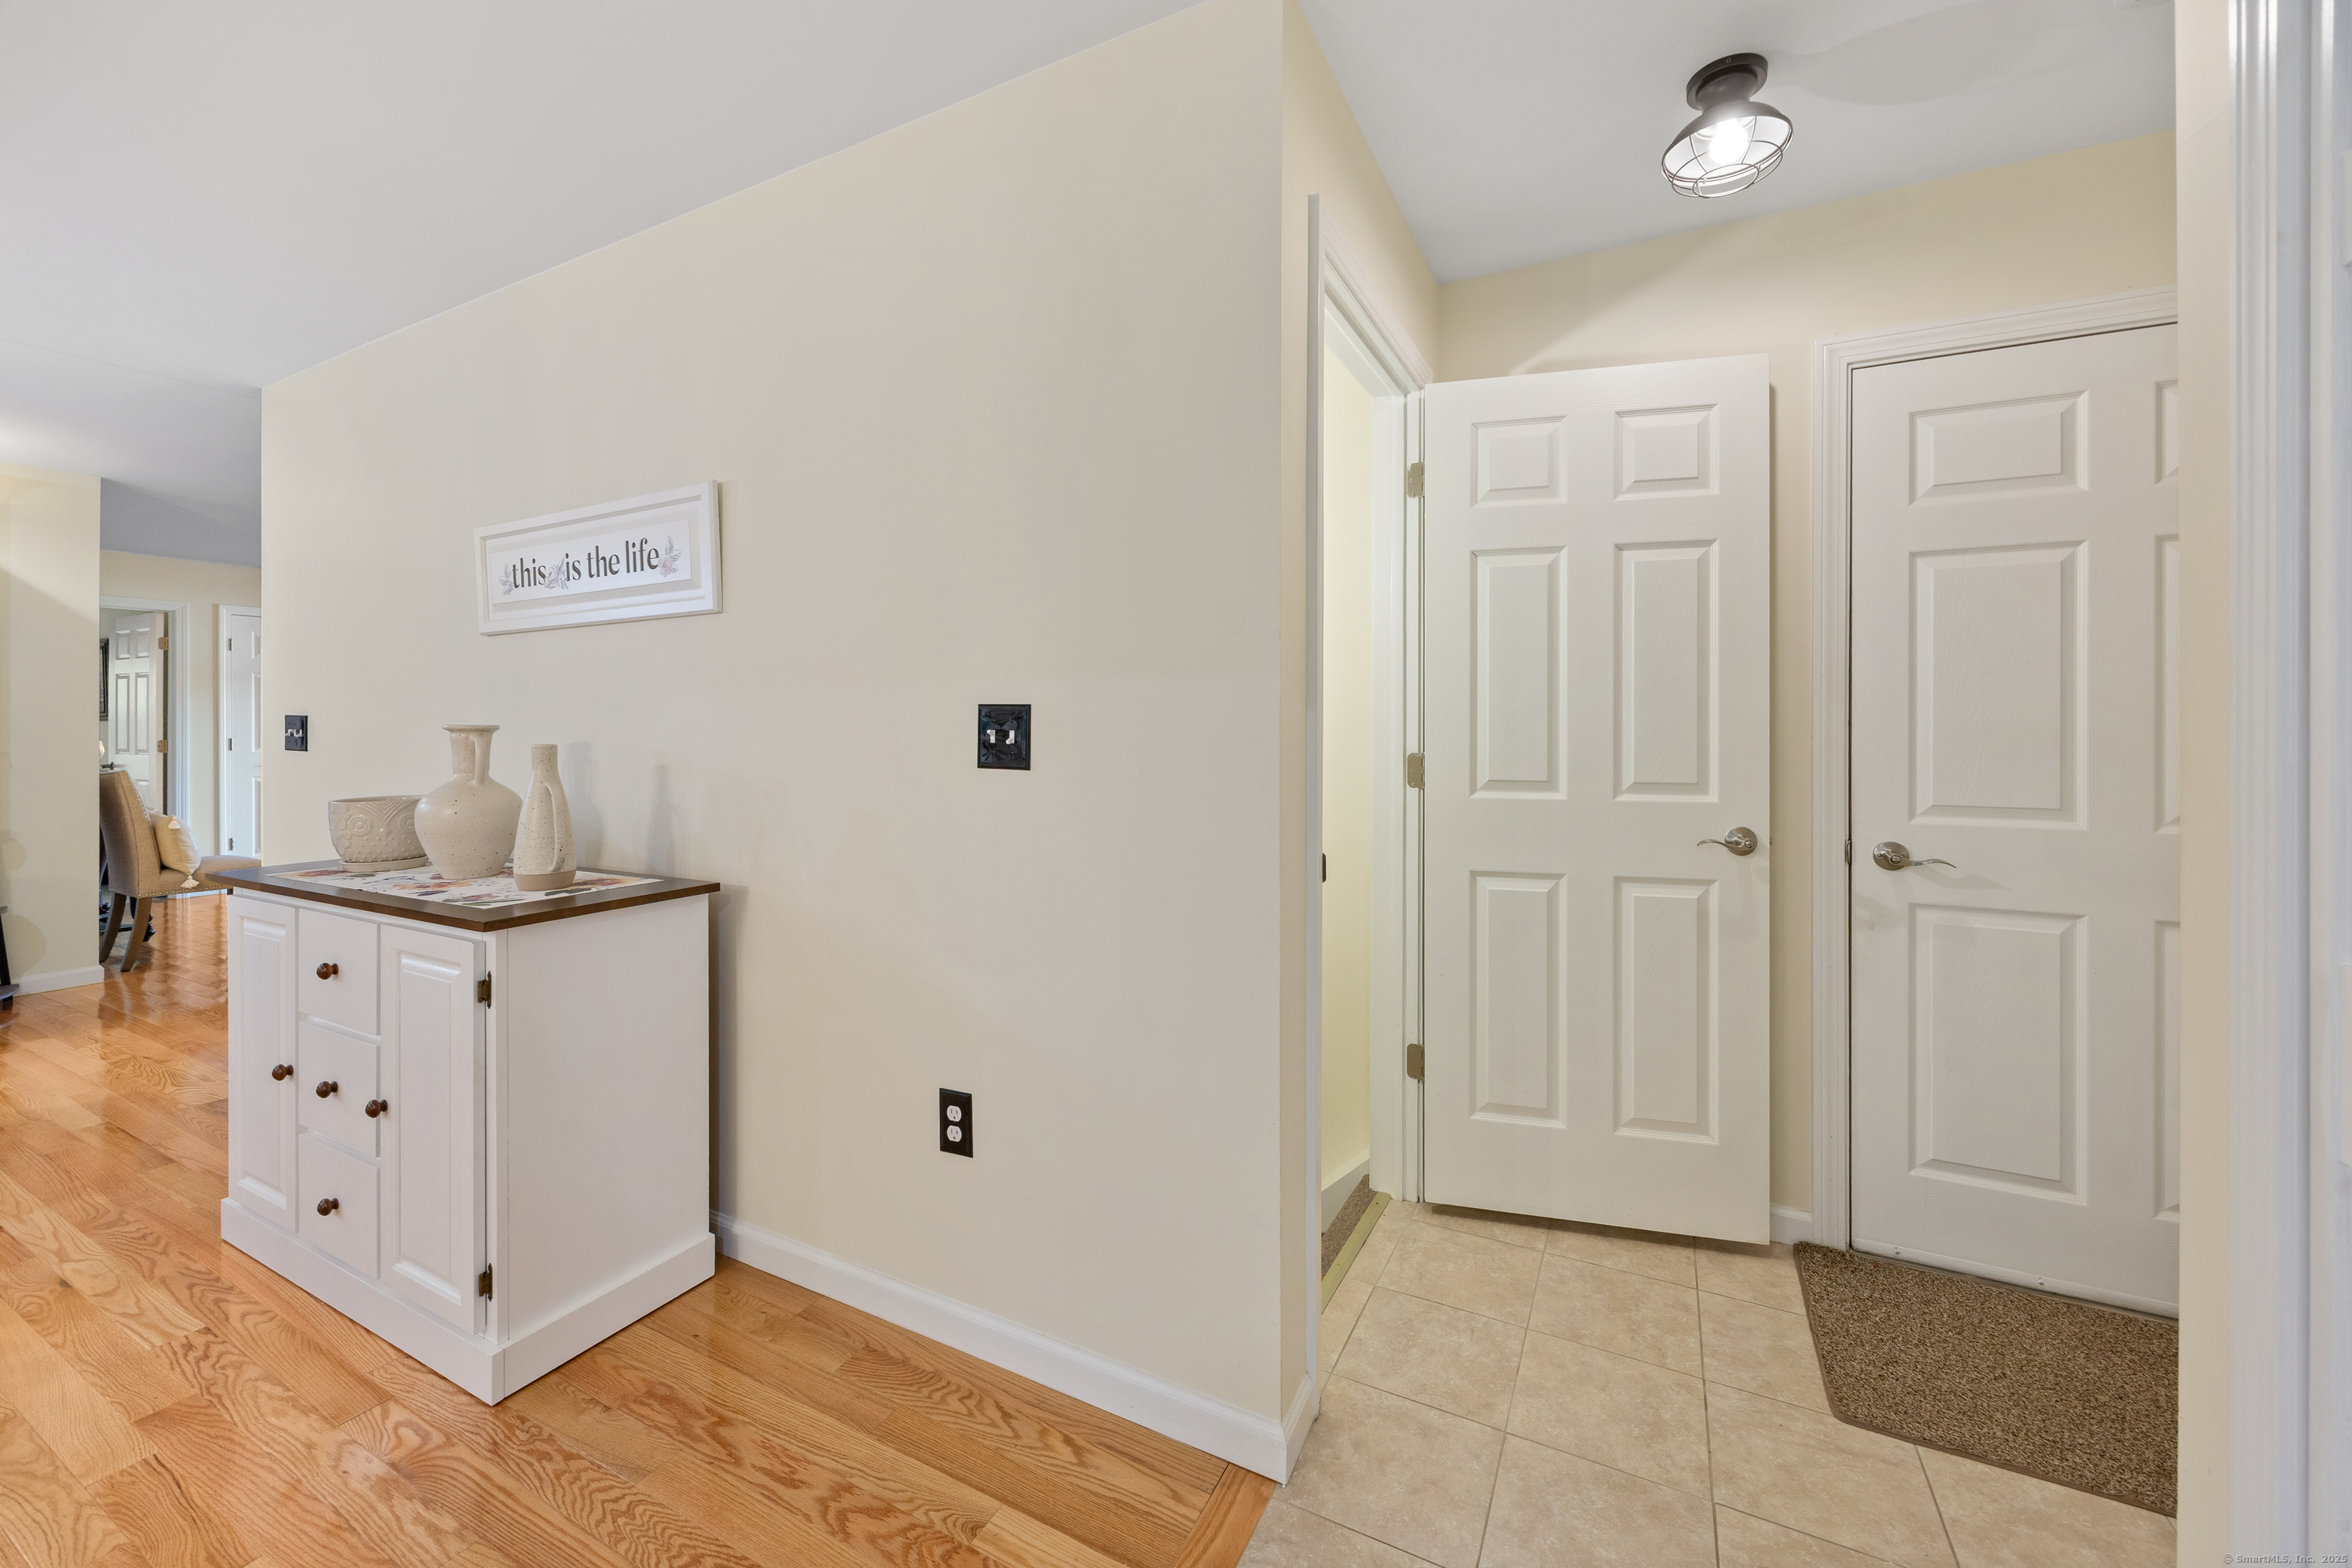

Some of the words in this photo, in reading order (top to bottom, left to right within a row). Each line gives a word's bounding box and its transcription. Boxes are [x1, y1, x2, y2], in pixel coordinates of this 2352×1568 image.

[512, 557, 546, 589] this
[565, 553, 581, 582] is
[586, 545, 620, 579] the
[625, 537, 659, 573] life
